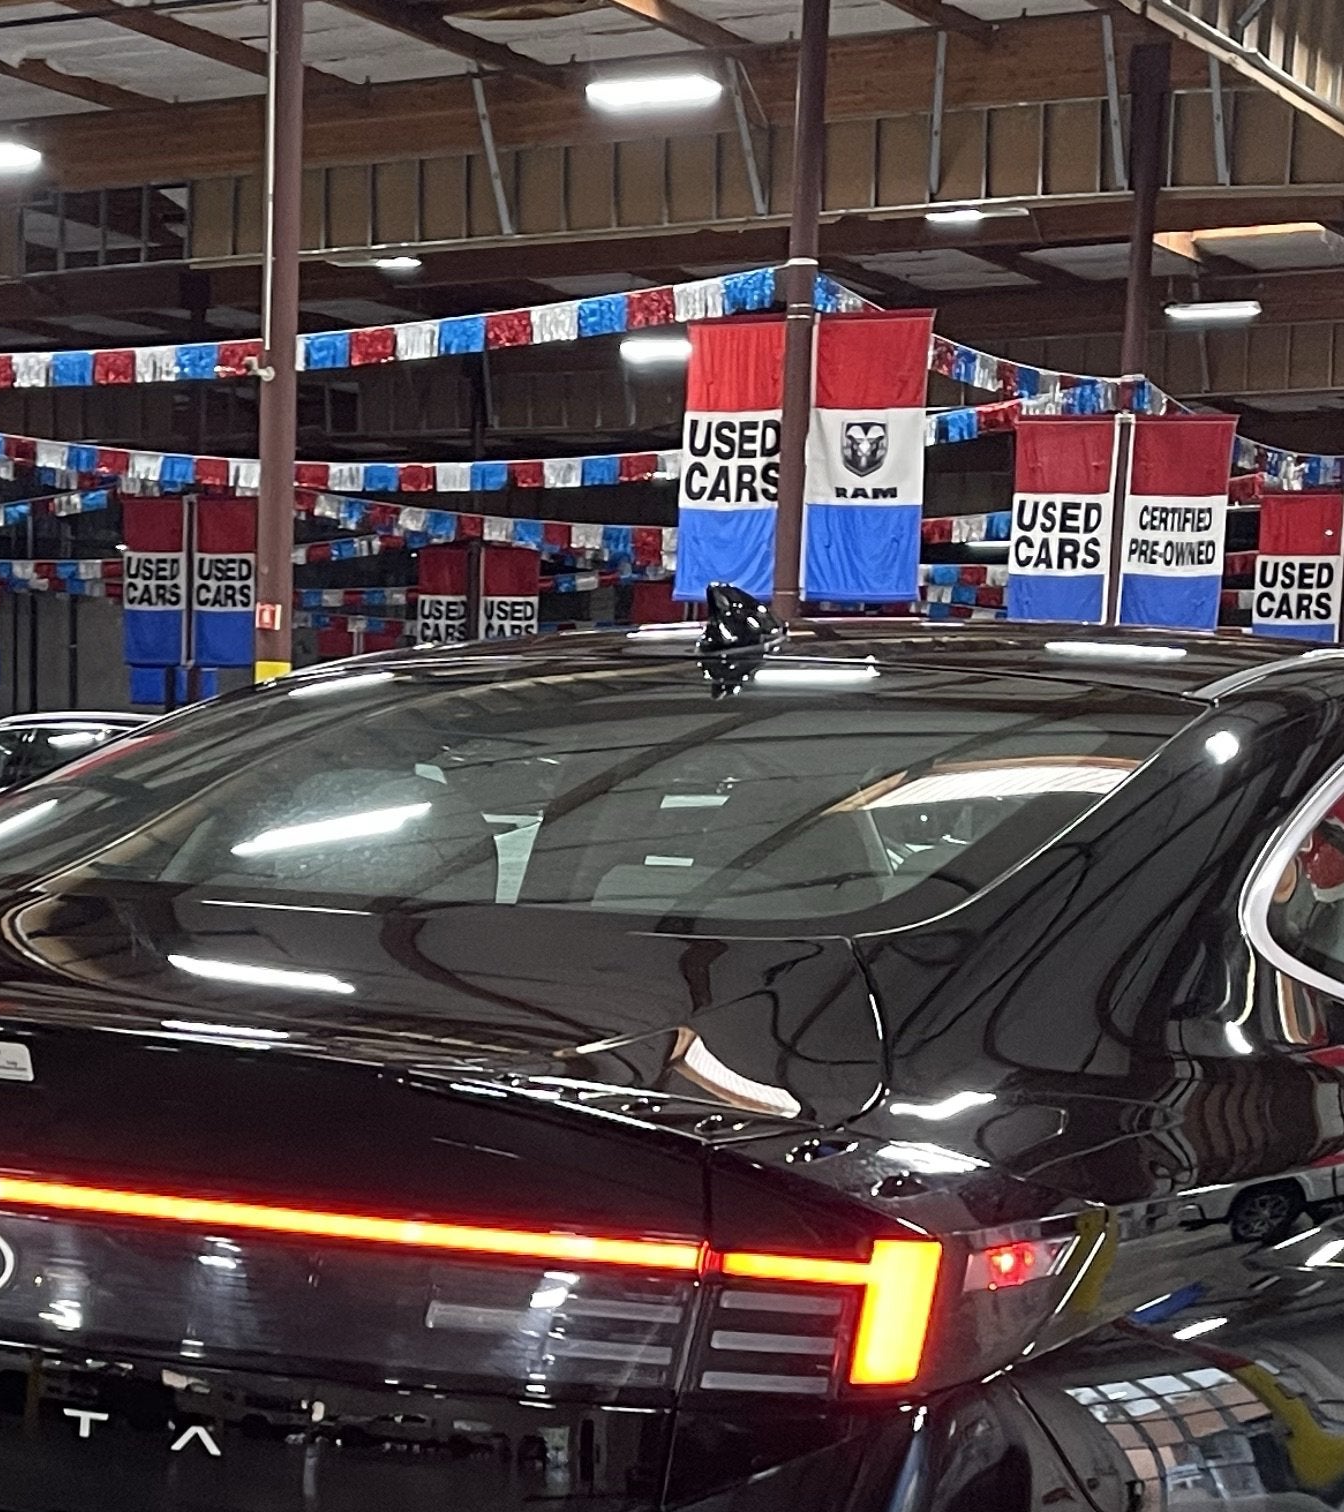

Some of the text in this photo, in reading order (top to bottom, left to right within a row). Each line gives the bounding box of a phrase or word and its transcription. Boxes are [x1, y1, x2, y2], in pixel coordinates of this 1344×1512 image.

[689, 419, 781, 459] USED
[684, 462, 779, 503] CARS
[835, 486, 898, 499] RAM
[1016, 499, 1102, 534] USED
[1139, 505, 1213, 532] CERTIFIED
[1014, 535, 1101, 569] CARS
[1127, 538, 1216, 567] PRE-OWNED
[126, 556, 181, 581] USED
[198, 557, 252, 581] USED
[1259, 561, 1334, 589] USED
[126, 582, 182, 606] CARS
[196, 583, 252, 607] CARS
[1256, 591, 1332, 620] CARS
[484, 600, 534, 621] USED
